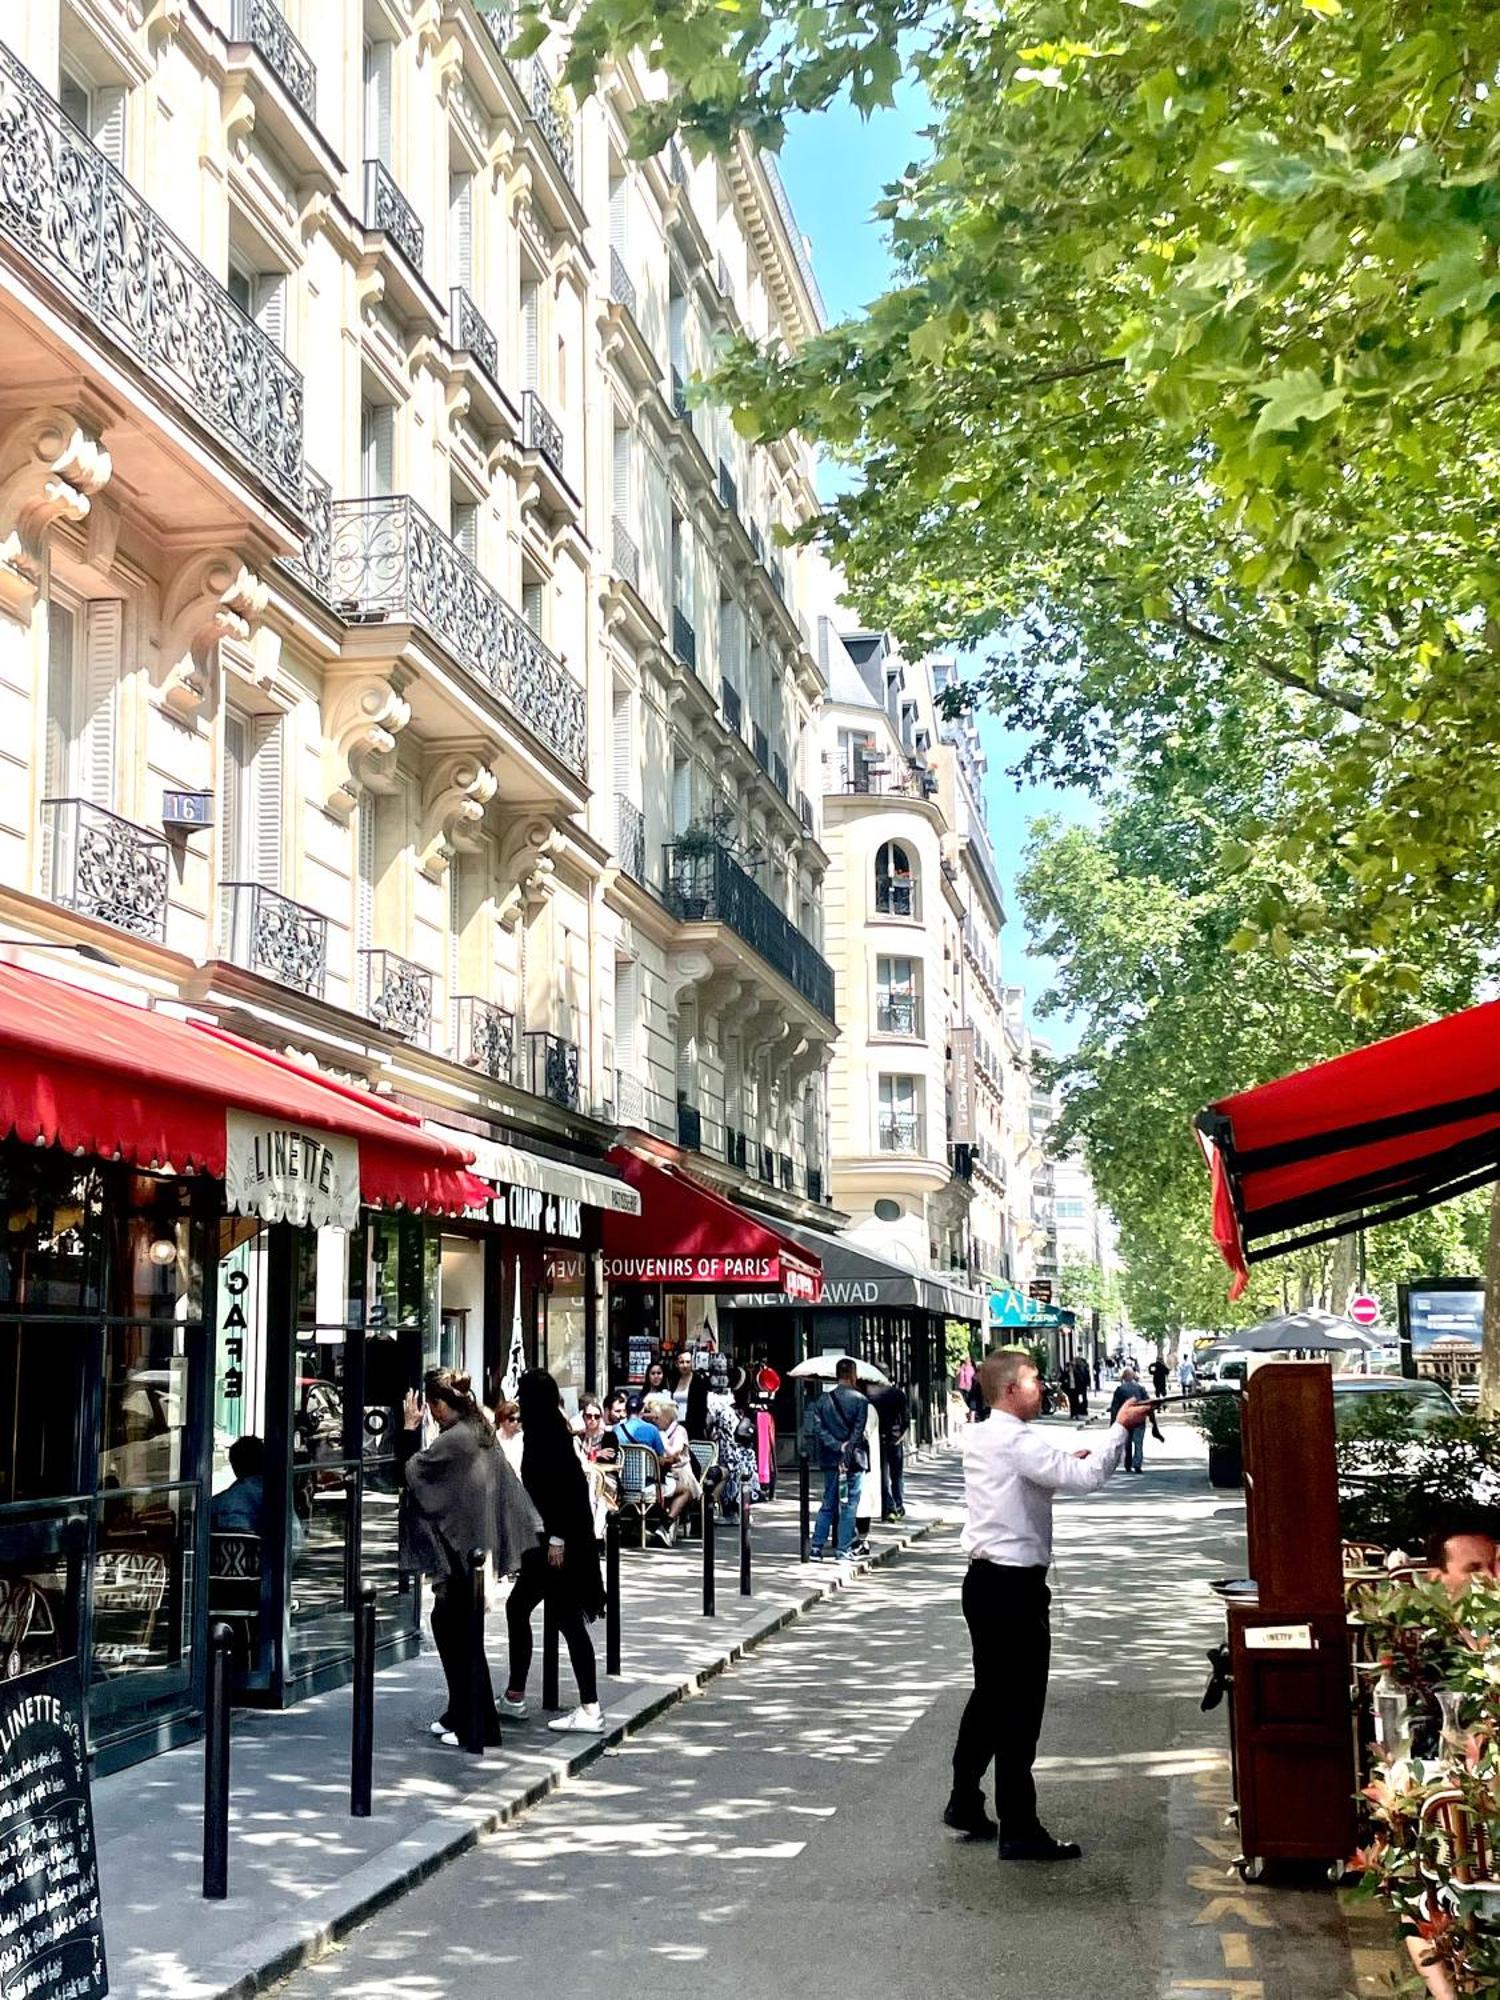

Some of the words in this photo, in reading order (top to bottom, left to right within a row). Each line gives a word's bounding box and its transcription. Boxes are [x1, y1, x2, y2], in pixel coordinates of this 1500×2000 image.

[172, 796, 195, 820] 16
[254, 1130, 333, 1195] LINETTE
[509, 1184, 543, 1231] CHAMP
[545, 1193, 557, 1235] de
[559, 1196, 582, 1239] MARS
[603, 1258, 692, 1276] SOUVENIRS
[698, 1258, 718, 1276] OF
[724, 1258, 769, 1276] PARIS
[0, 1695, 61, 1754] LINETTE
